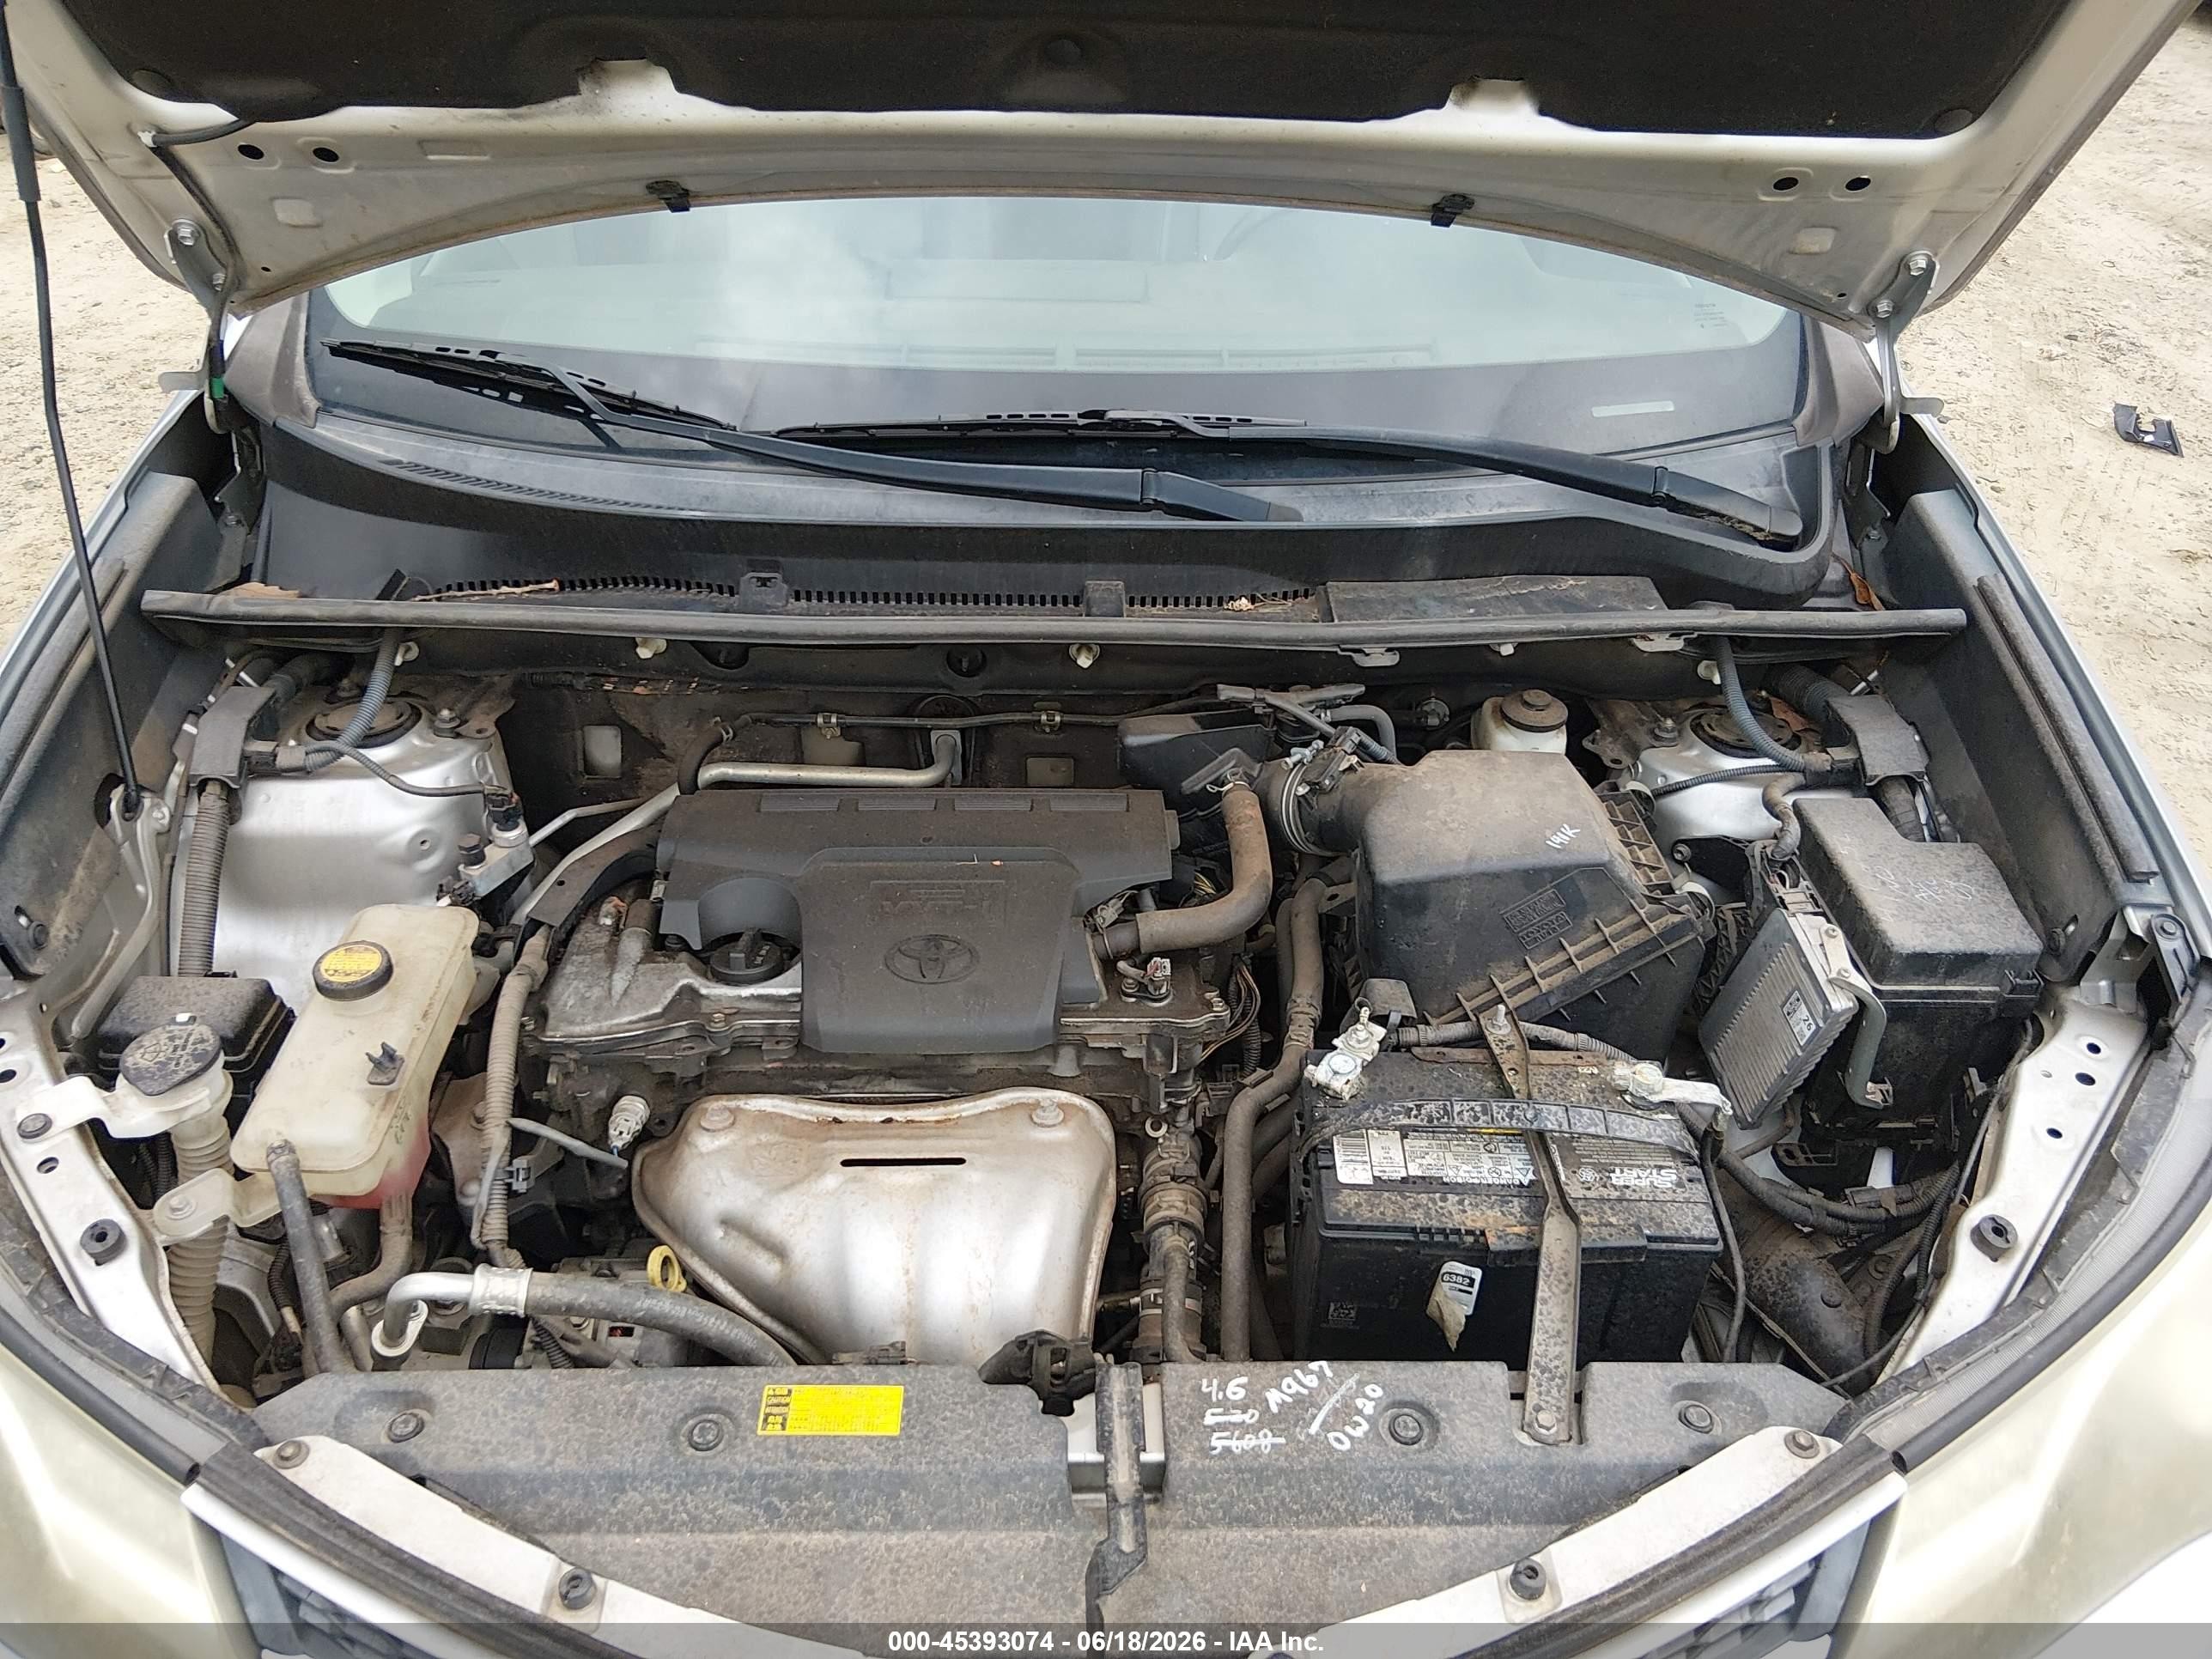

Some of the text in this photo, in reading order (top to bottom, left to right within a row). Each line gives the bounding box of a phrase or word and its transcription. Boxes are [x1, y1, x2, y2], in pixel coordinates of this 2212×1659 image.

[1609, 1168, 1677, 1180] START
[1611, 1176, 1672, 1188] SUPER
[1443, 1273, 1470, 1285] 6382
[1201, 1376, 1249, 1402] 4.6
